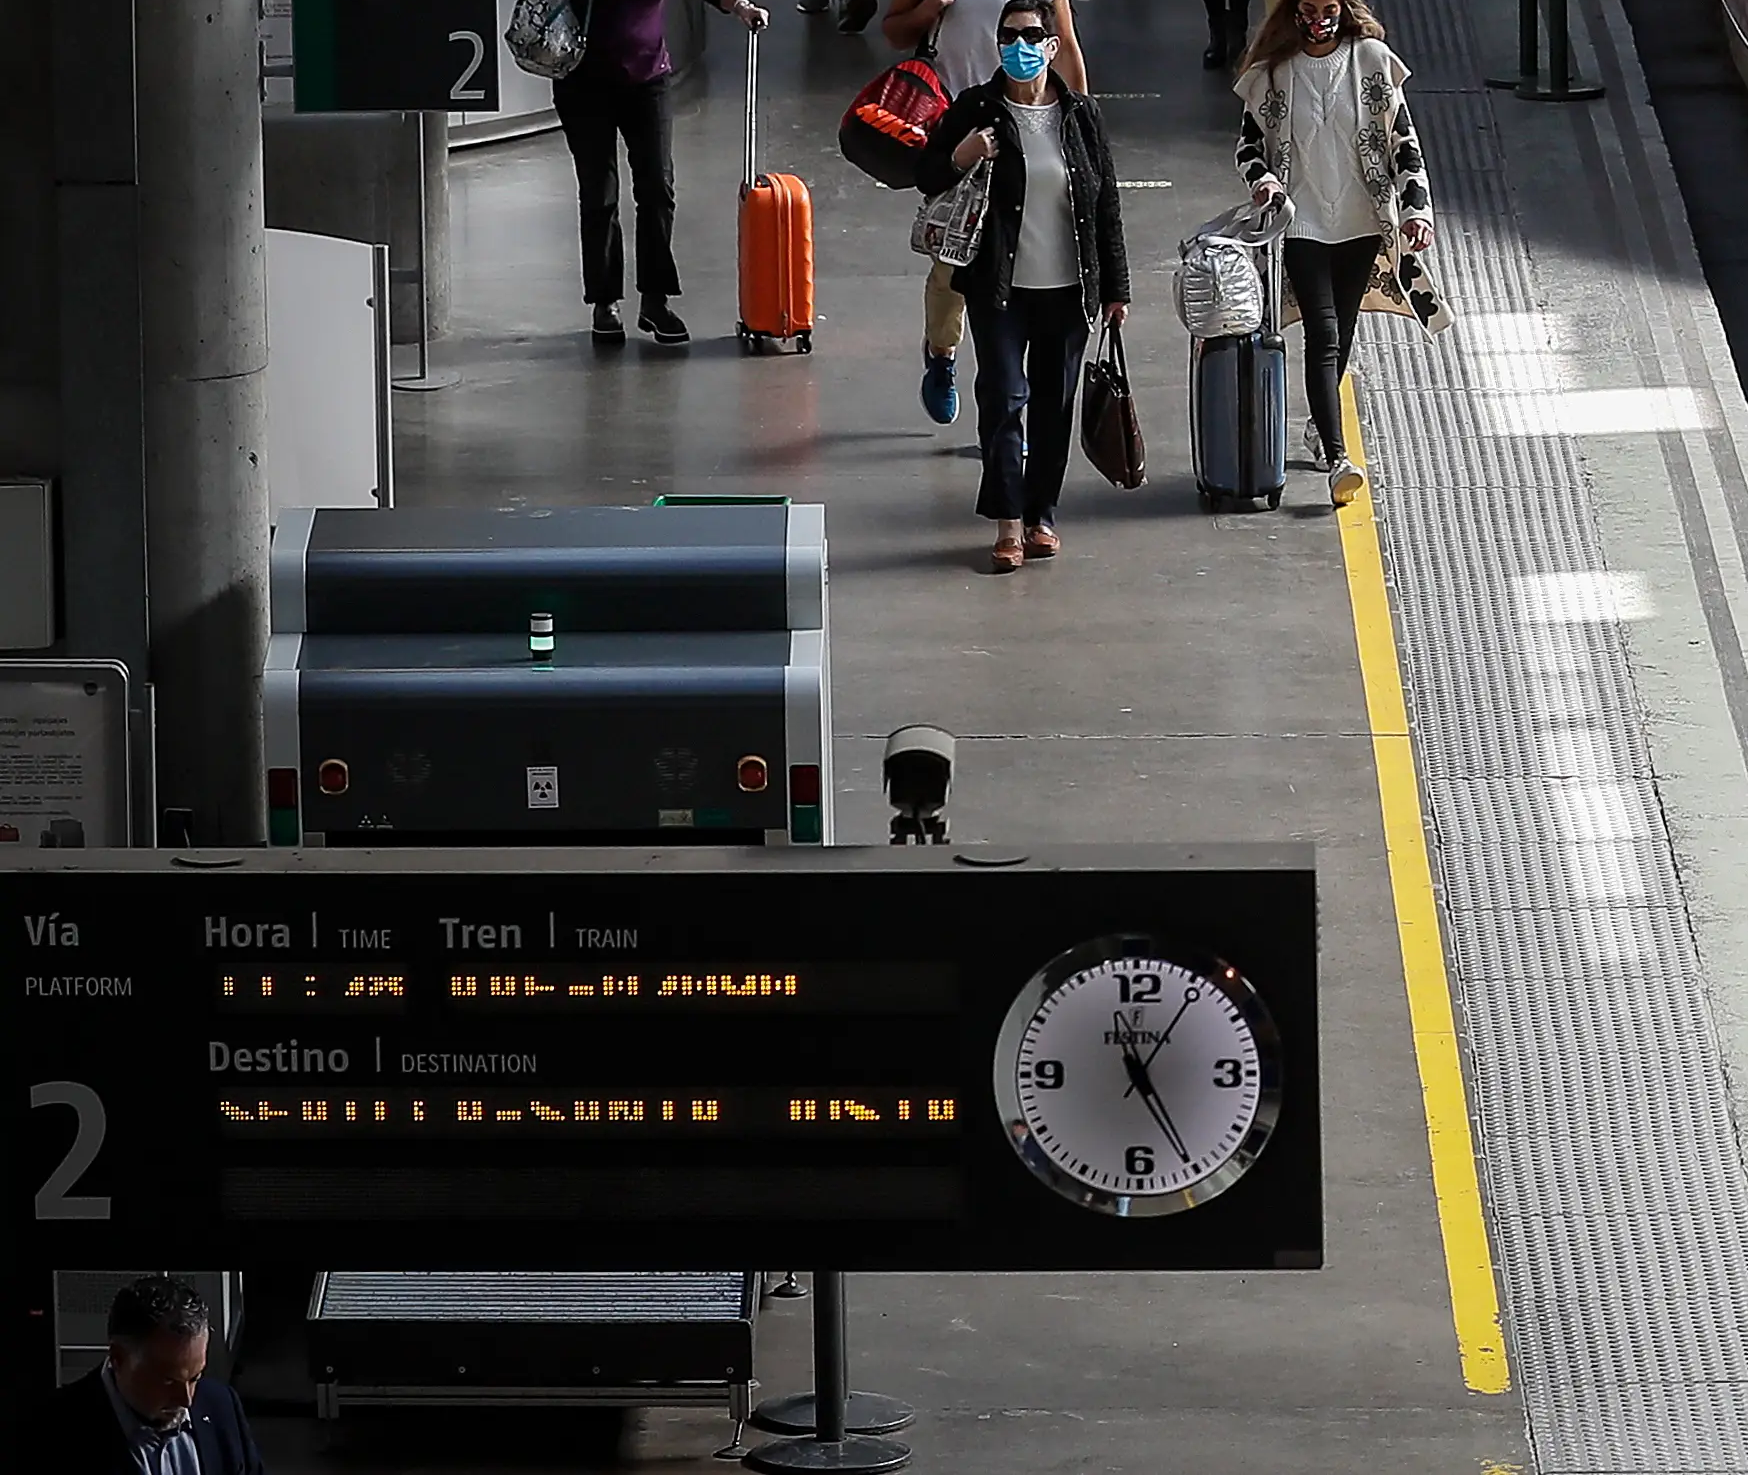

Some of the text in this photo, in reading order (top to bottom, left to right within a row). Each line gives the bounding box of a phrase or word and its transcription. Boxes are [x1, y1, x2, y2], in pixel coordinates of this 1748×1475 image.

[448, 30, 486, 100] 2
[25, 912, 80, 948] Vía
[205, 916, 392, 950] Hora TIME
[439, 917, 639, 950] Tren TRAIN
[25, 976, 133, 997] PLATFORM
[1112, 973, 1162, 1003] 12
[1103, 1030, 1172, 1045] FESTINA
[209, 1040, 538, 1074] Destino DESTINATION
[1034, 1060, 1065, 1090] 9
[1212, 1059, 1243, 1088] 3
[29, 1079, 112, 1220] 2
[1124, 1145, 1155, 1176] 6
